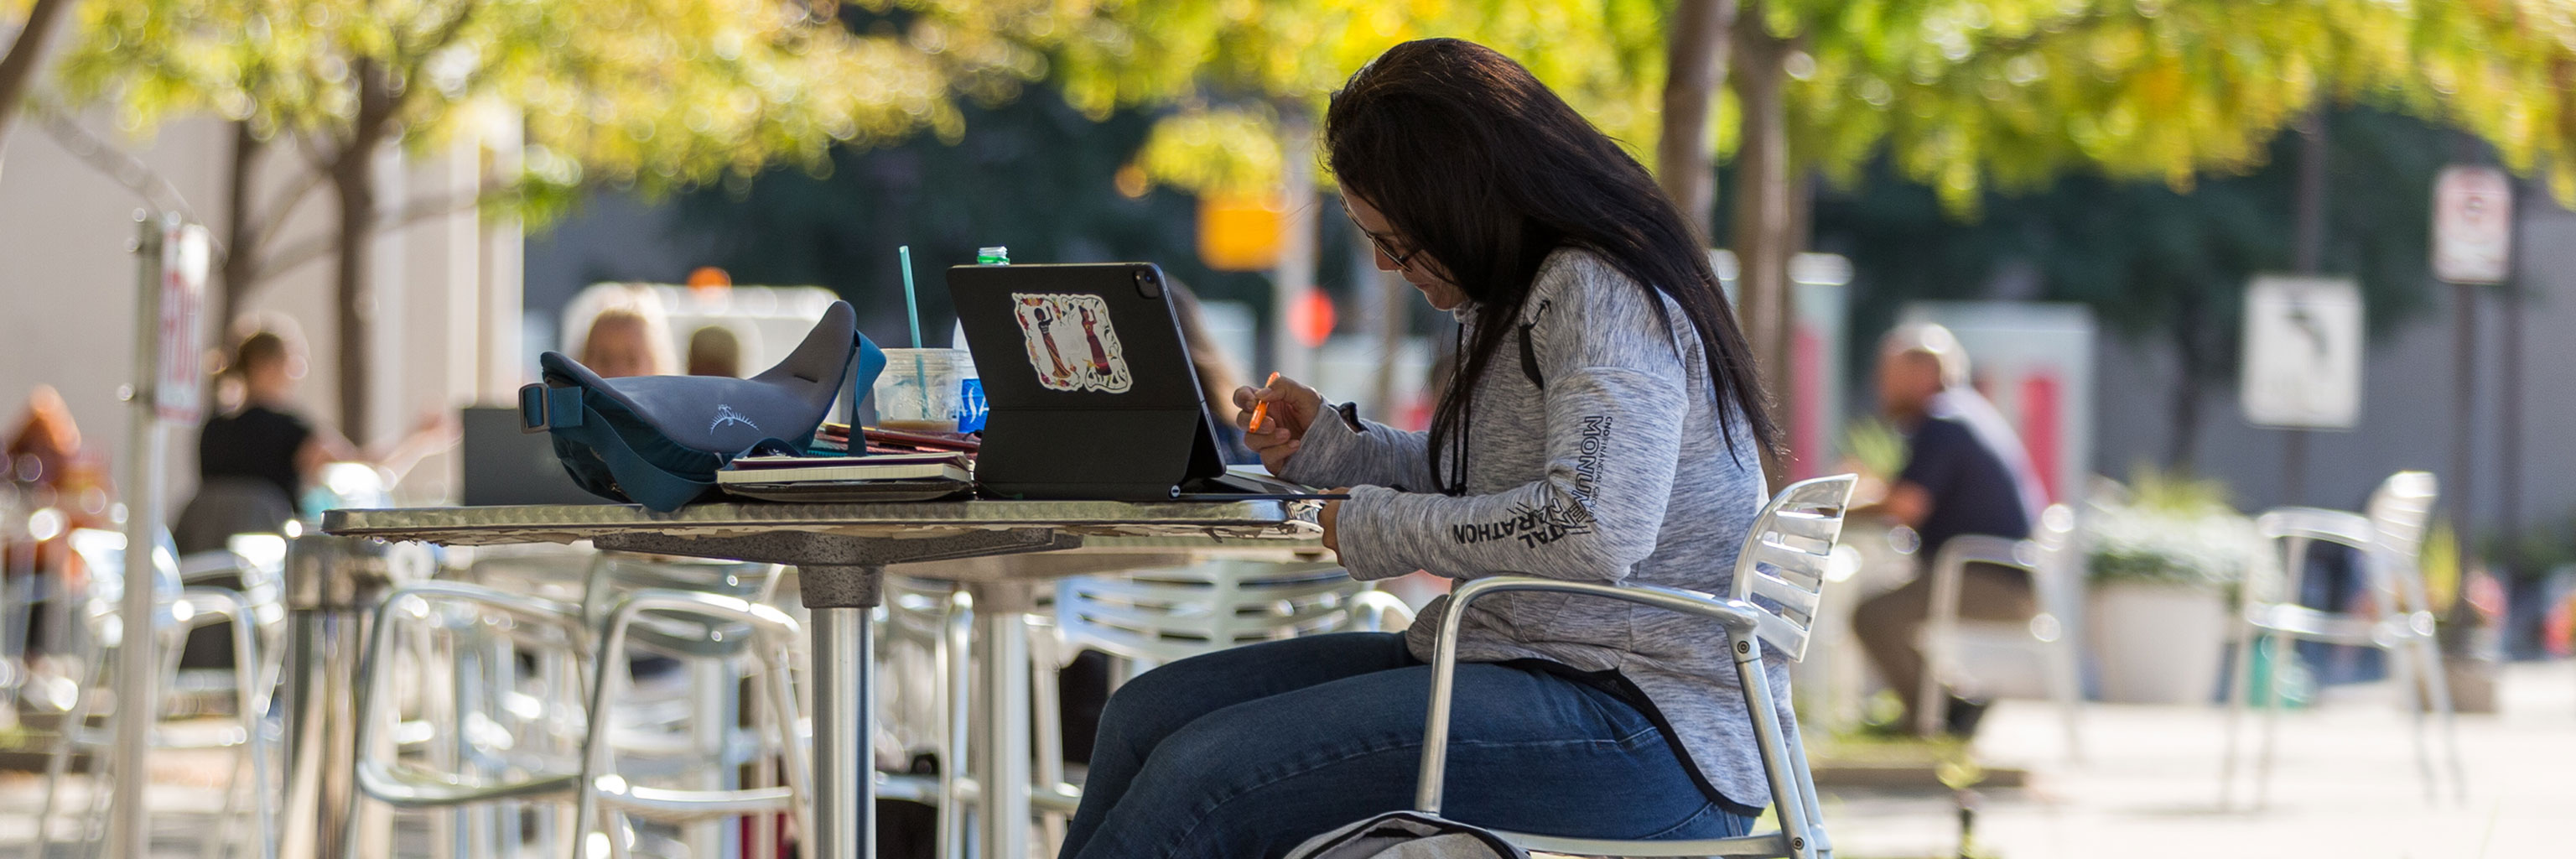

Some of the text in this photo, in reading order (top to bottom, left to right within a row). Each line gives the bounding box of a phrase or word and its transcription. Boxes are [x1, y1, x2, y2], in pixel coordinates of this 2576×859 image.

[1588, 416, 1613, 518] CNO FINANCIAL GROUP
